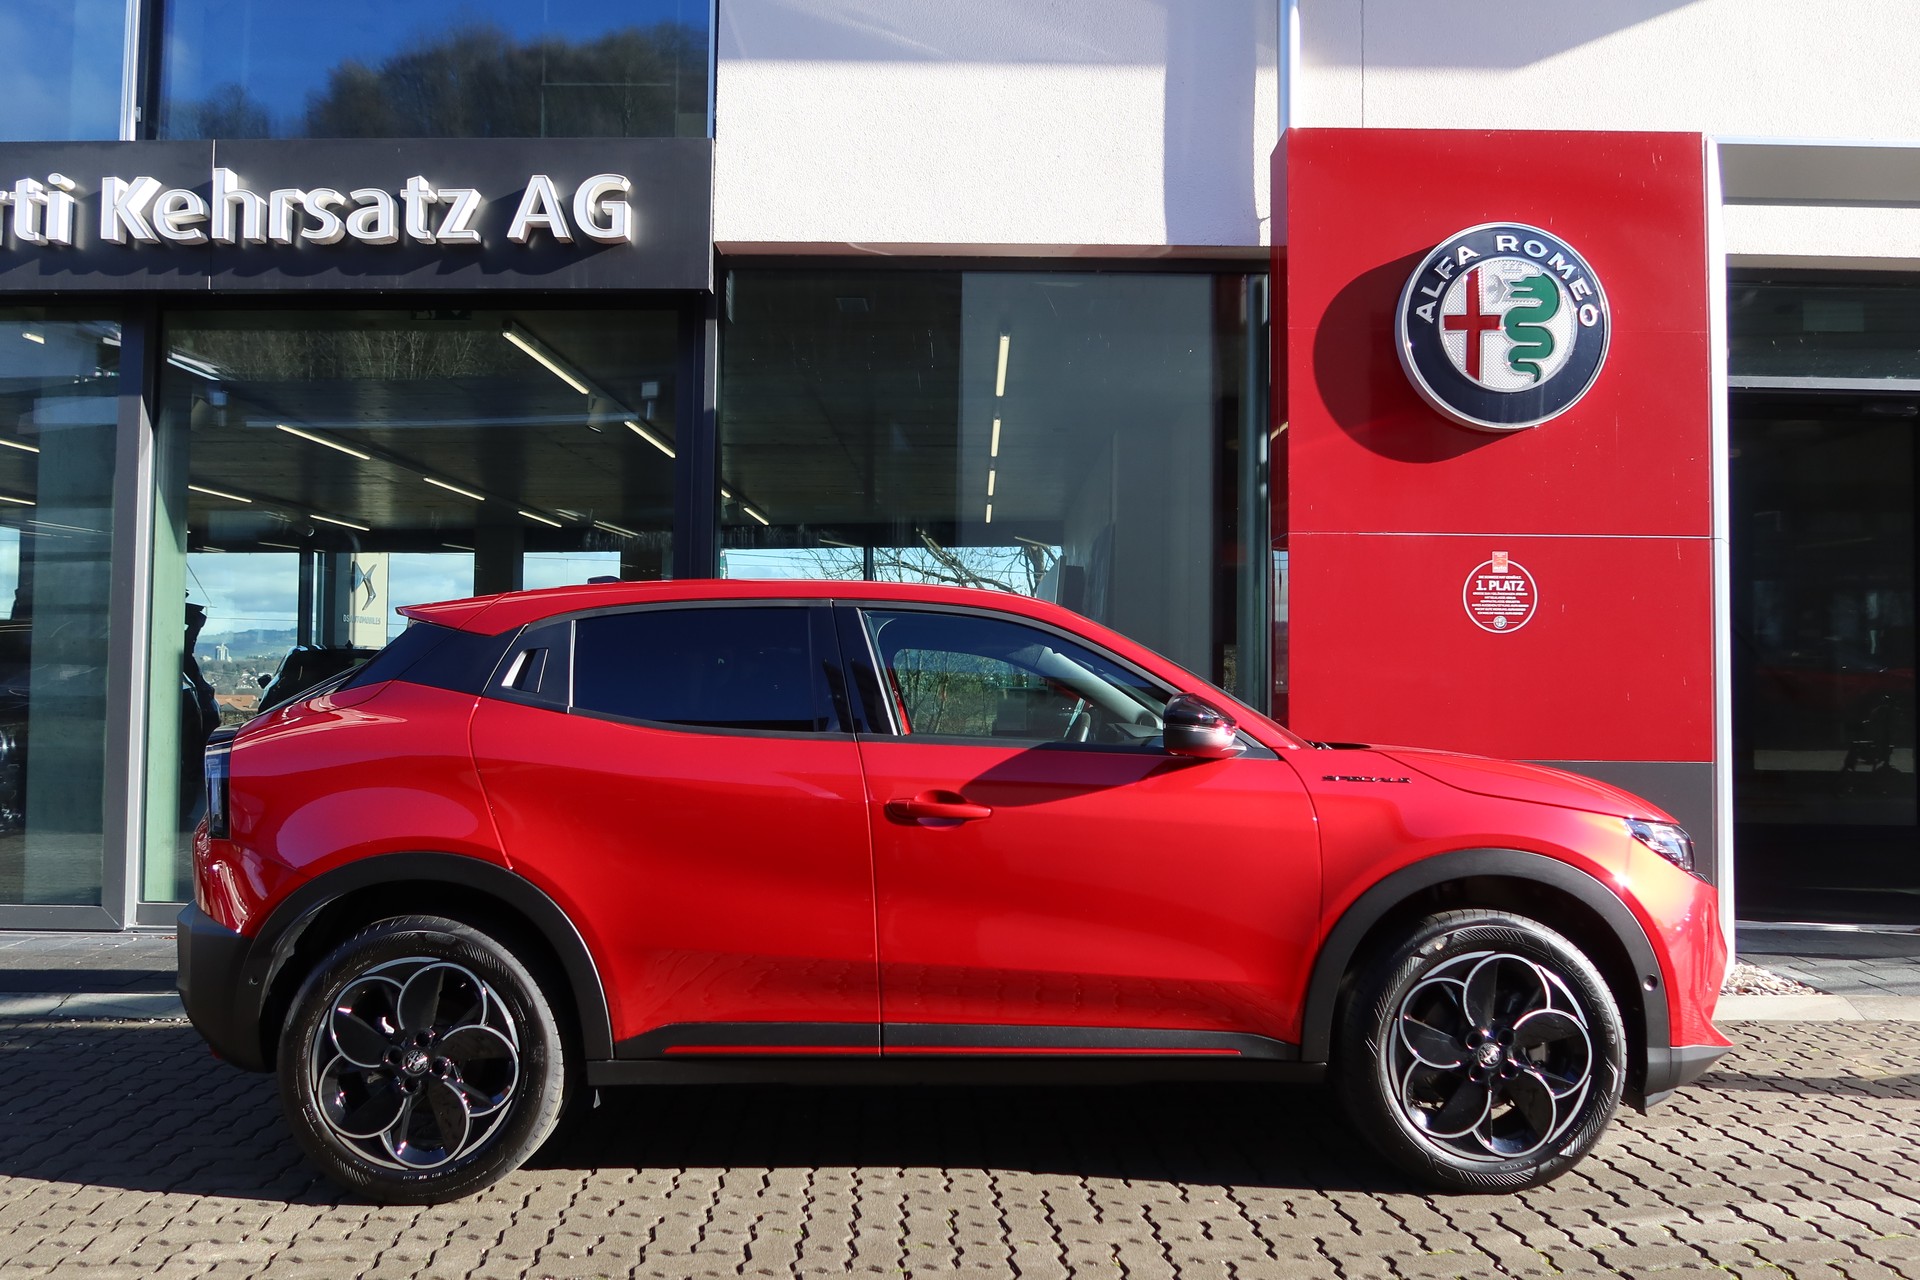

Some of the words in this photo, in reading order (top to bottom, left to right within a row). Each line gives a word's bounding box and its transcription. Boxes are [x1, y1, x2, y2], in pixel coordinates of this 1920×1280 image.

[100, 167, 482, 245] Kehrsatz
[506, 173, 632, 244] AG
[1416, 245, 1480, 325] ALFA
[1495, 235, 1599, 327] ROMEO
[1475, 580, 1487, 591] 1.
[1488, 580, 1526, 592] PLATZ
